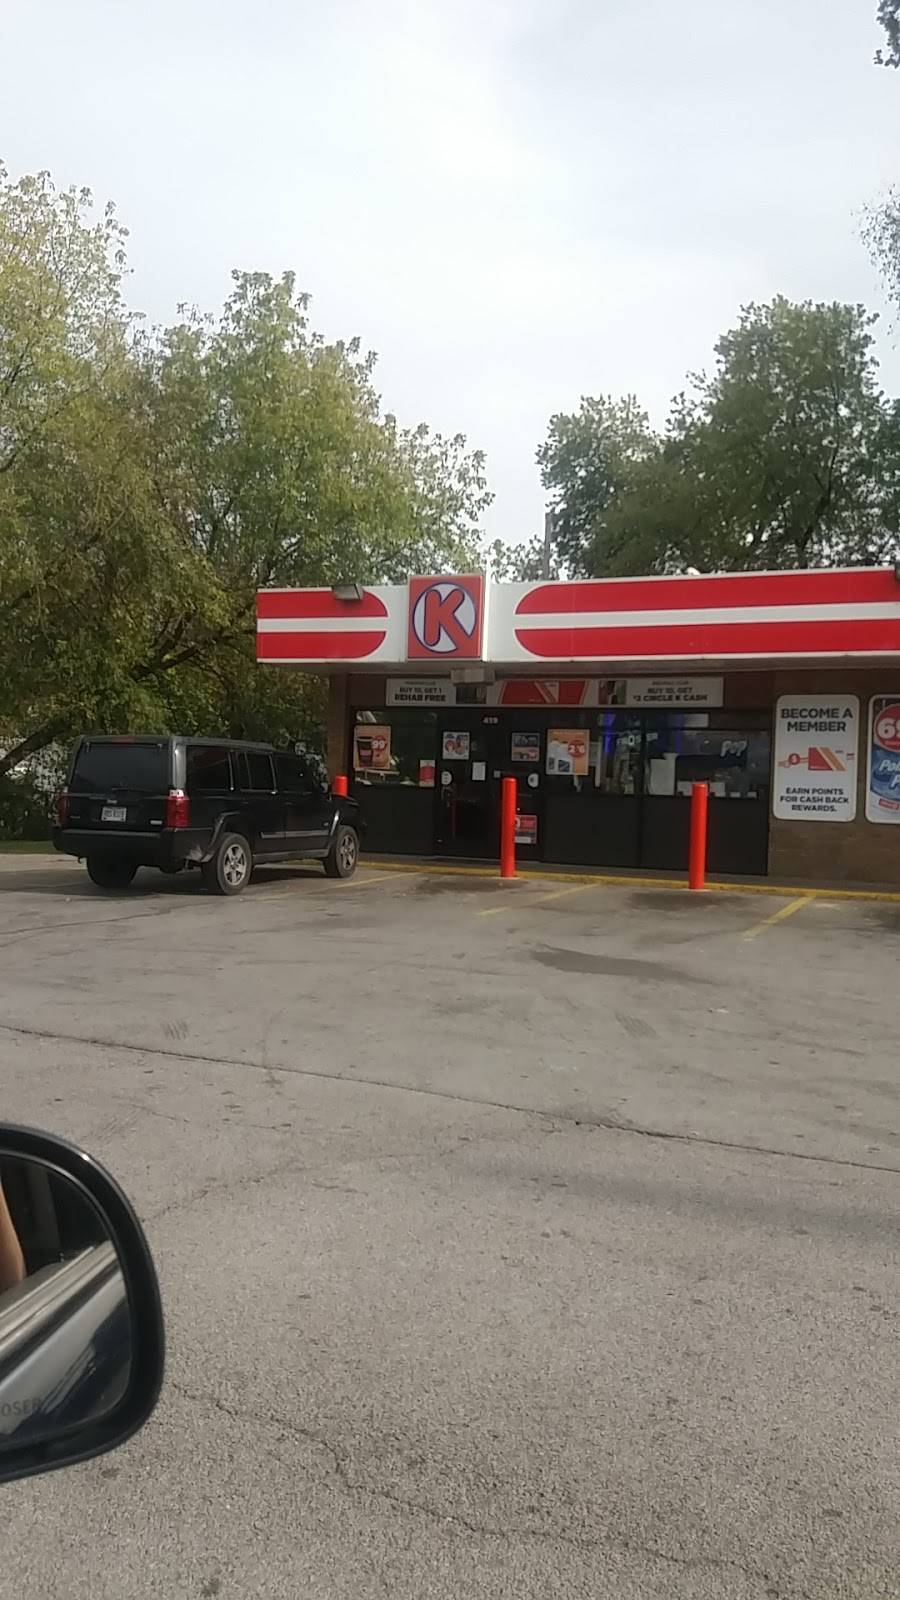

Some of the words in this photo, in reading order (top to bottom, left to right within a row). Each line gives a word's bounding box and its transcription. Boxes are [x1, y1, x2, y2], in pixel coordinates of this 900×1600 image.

[422, 587, 472, 654] K
[425, 694, 446, 702] FREE
[781, 708, 839, 719] BECOME
[842, 708, 853, 718] A
[787, 721, 846, 732] MEMBER
[811, 787, 843, 795] POINTS
[791, 804, 837, 812] REWARDS.
